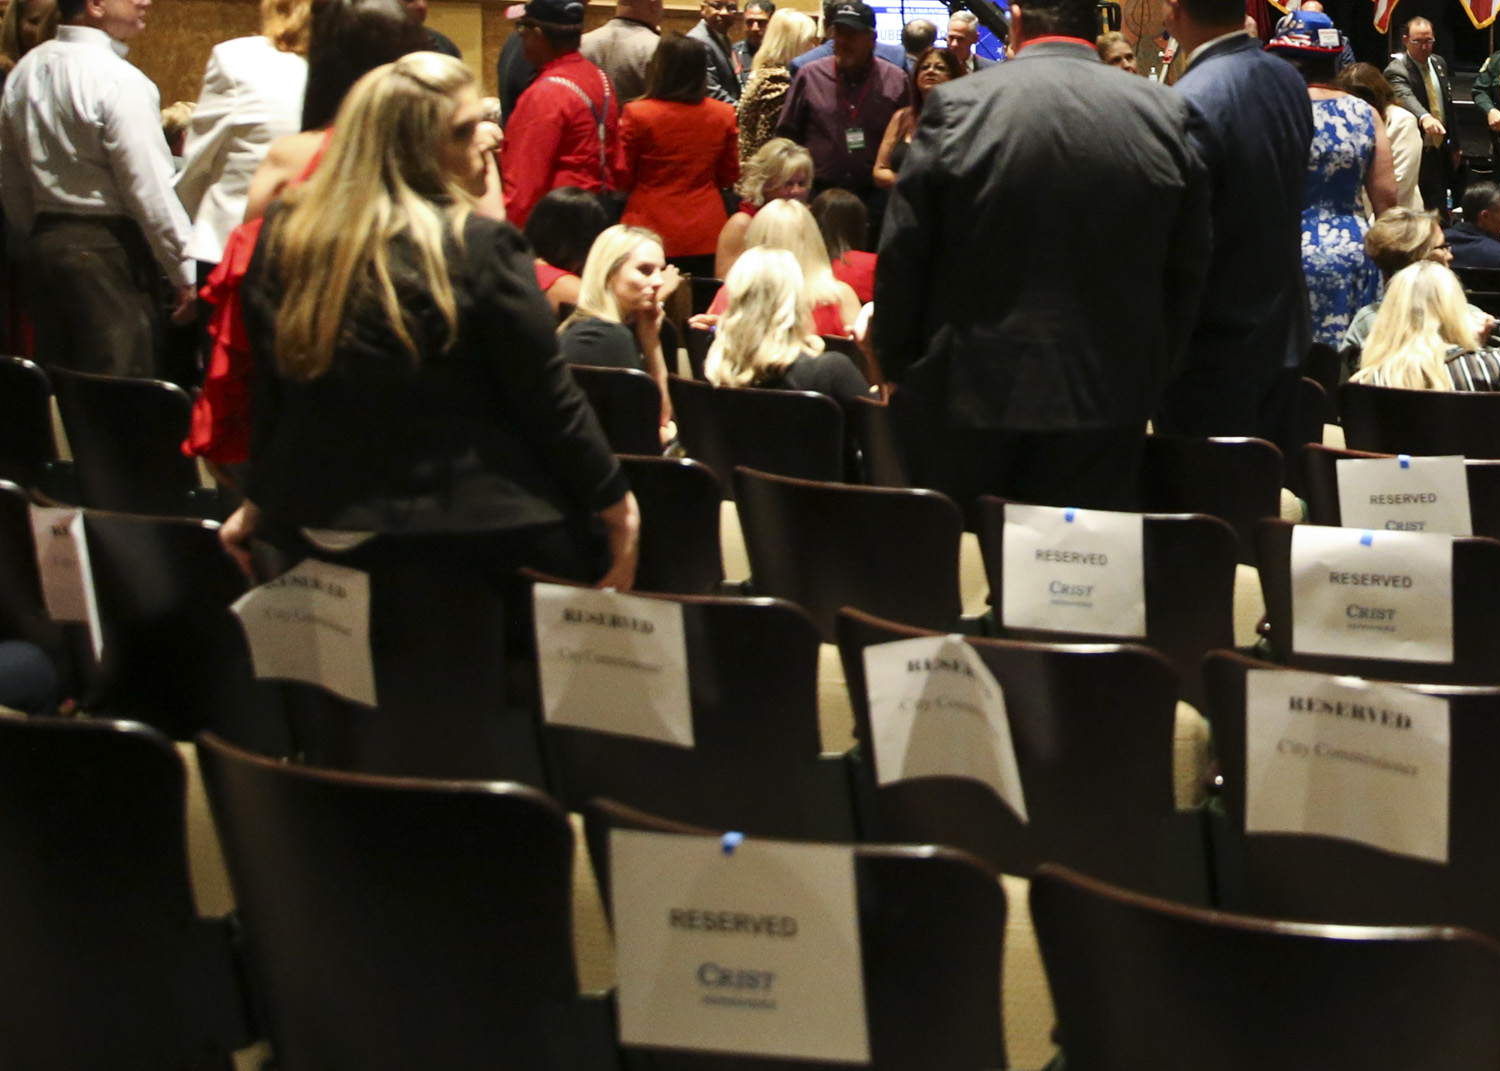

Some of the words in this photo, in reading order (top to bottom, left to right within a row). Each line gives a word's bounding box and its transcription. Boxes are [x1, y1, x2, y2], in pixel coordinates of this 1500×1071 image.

[1369, 493, 1438, 505] RESERVED
[1035, 548, 1109, 566] RESERVED
[1329, 571, 1413, 589] RESERVED
[1288, 695, 1413, 730] RESERVED
[669, 907, 799, 938] RESERVED
